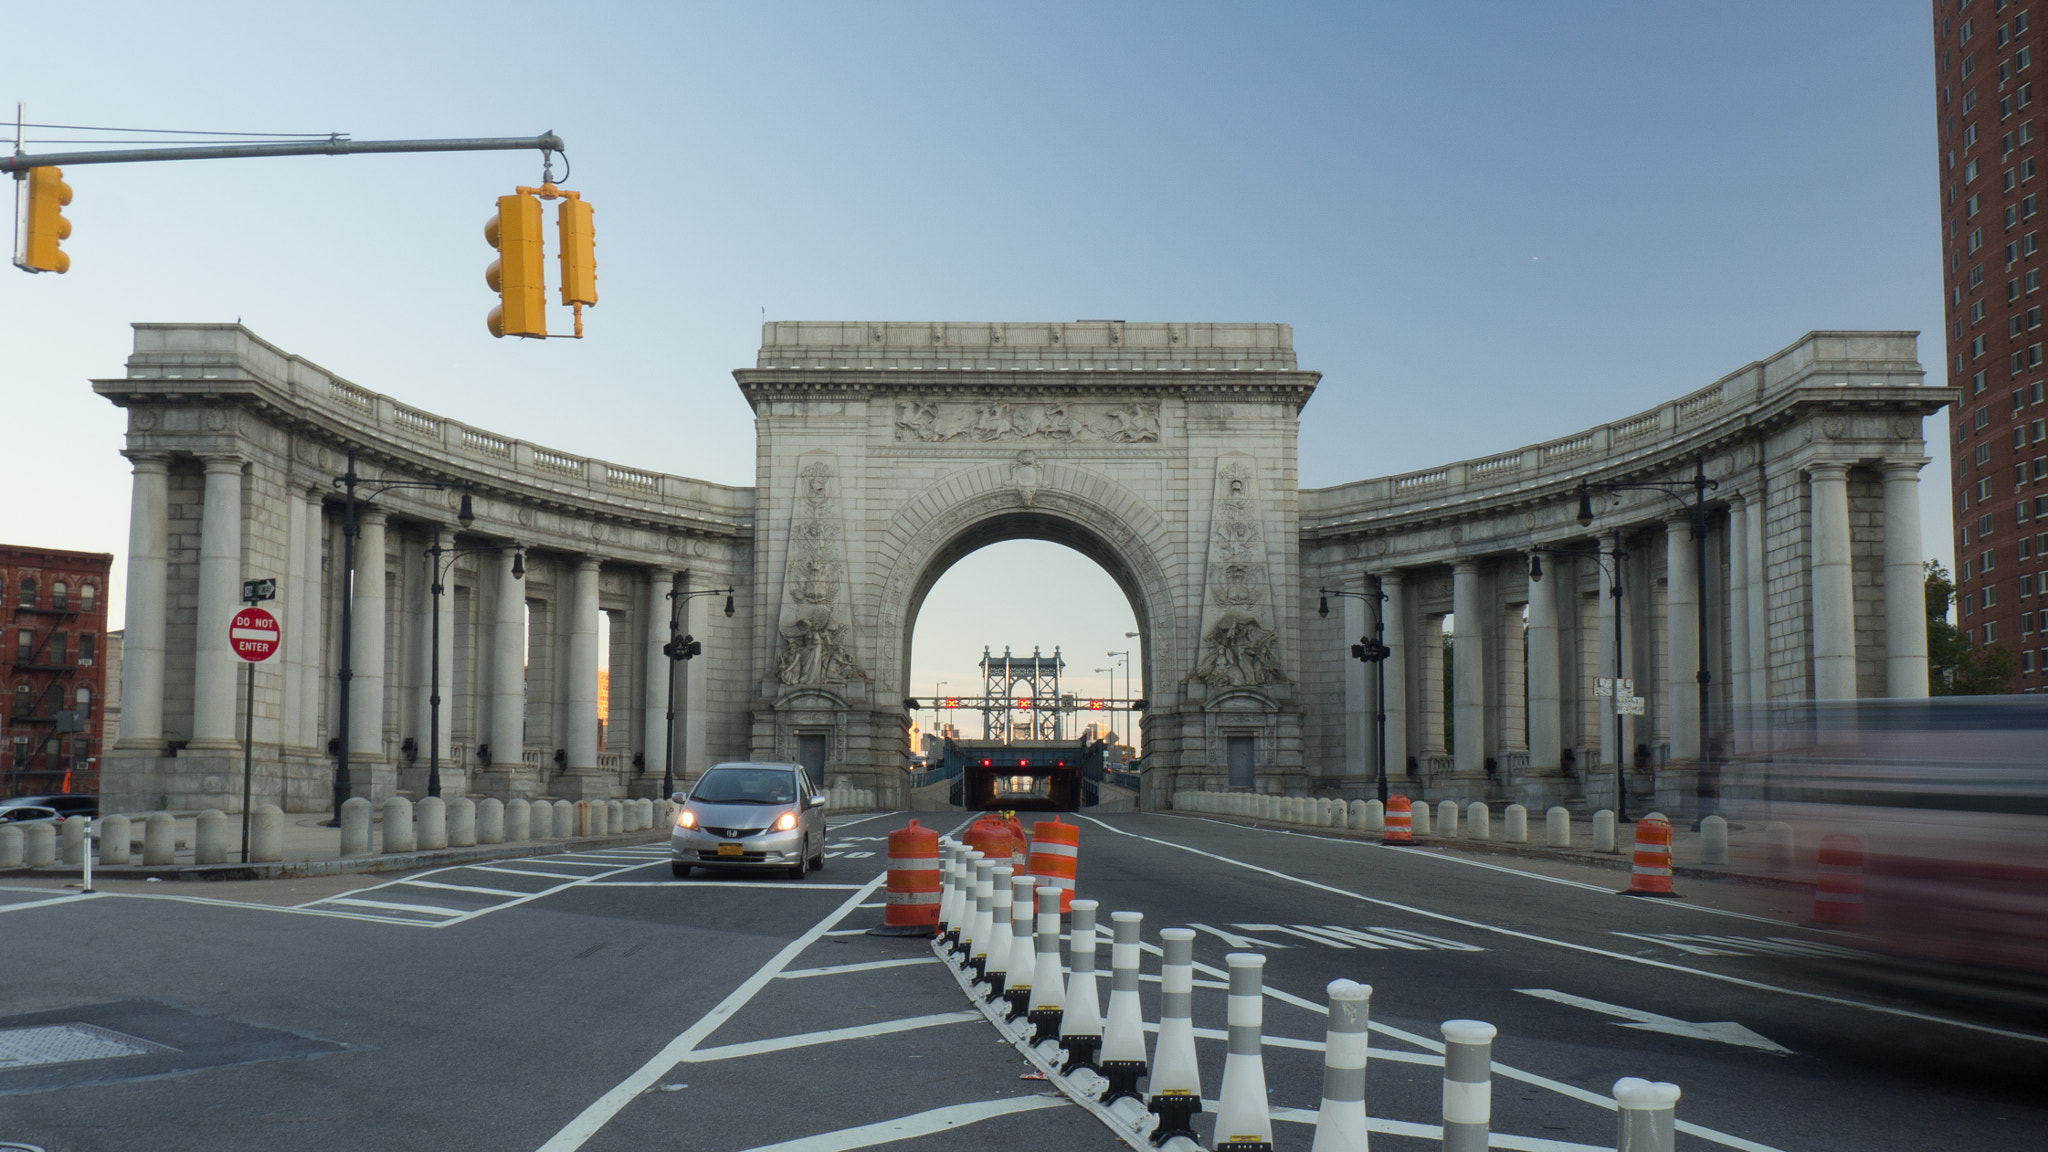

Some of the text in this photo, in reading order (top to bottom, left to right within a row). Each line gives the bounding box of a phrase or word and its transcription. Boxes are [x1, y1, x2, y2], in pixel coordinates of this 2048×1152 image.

[236, 616, 273, 628] DO NOT
[239, 641, 269, 652] ENTER
